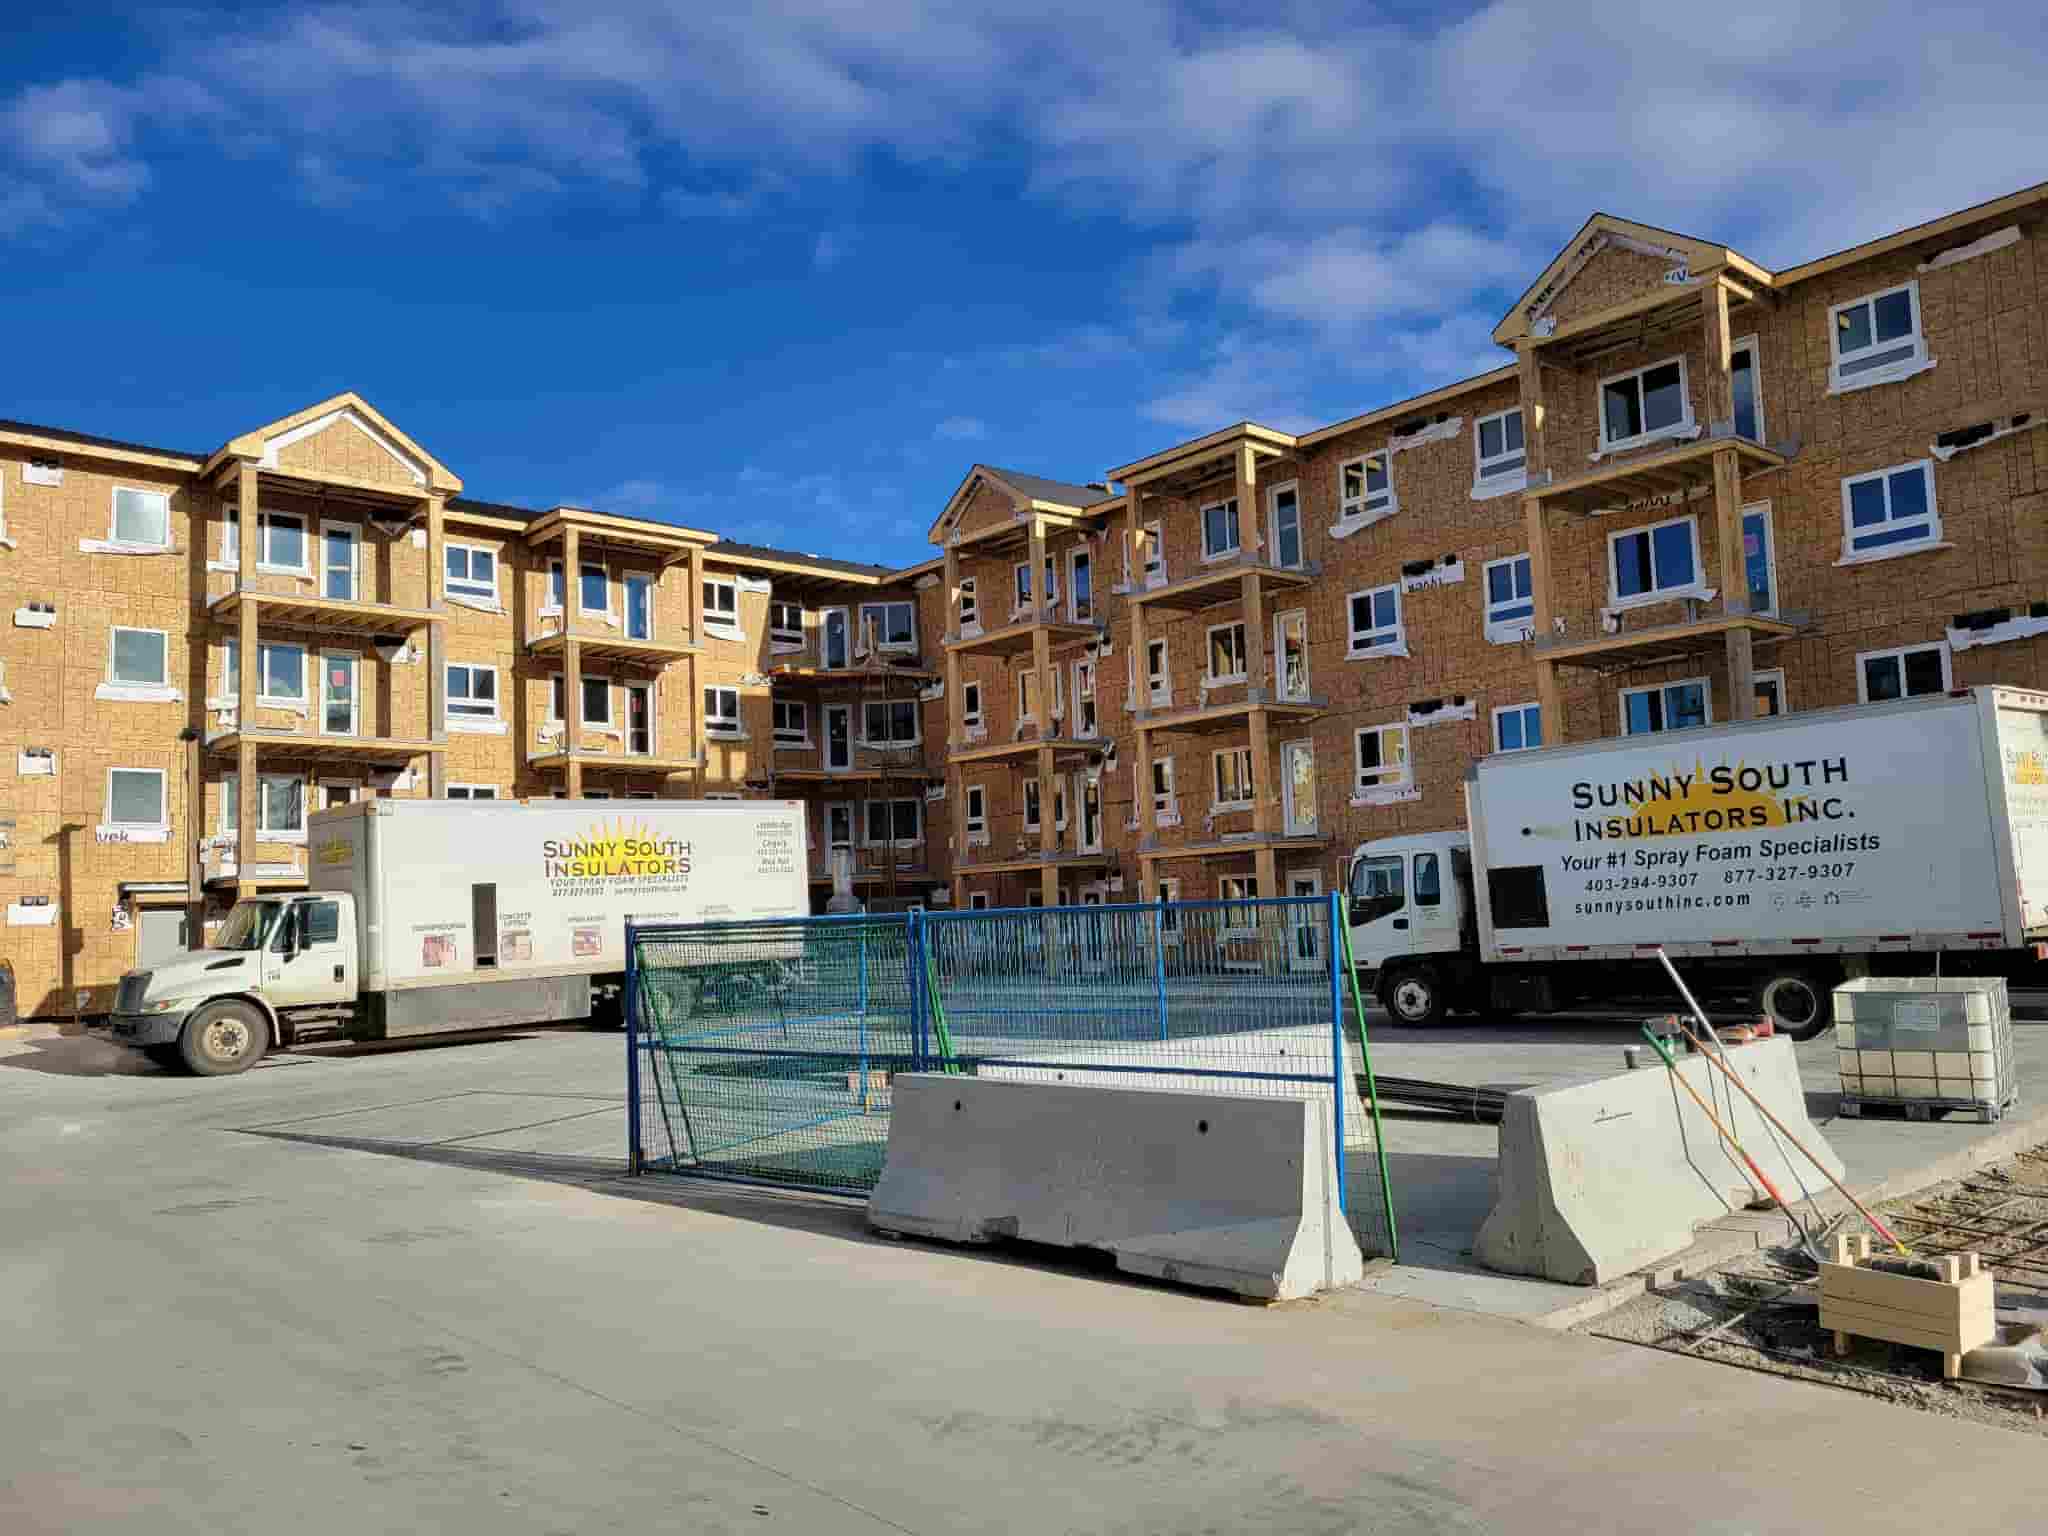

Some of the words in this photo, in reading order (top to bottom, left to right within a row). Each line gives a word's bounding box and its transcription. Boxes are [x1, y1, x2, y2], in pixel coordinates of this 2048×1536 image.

[1572, 774, 1695, 809] SUNNY
[1711, 757, 1848, 795] SOUTH
[1575, 806, 1768, 842] INSULATORS
[1784, 798, 1855, 823] INC.
[543, 840, 617, 858] SUNNY
[624, 838, 691, 857] SOUTH
[1561, 855, 1601, 872] Your
[1607, 851, 1627, 868] #1
[1634, 849, 1689, 869] Spray
[1697, 843, 1751, 862] Foam
[1760, 833, 1881, 858] Specialists
[544, 857, 692, 878] INSULATORS
[1585, 872, 1698, 892] 403-294-9307
[1724, 862, 1855, 884] 877-327-9307
[1575, 892, 1751, 915] sunnysouthinc.com
